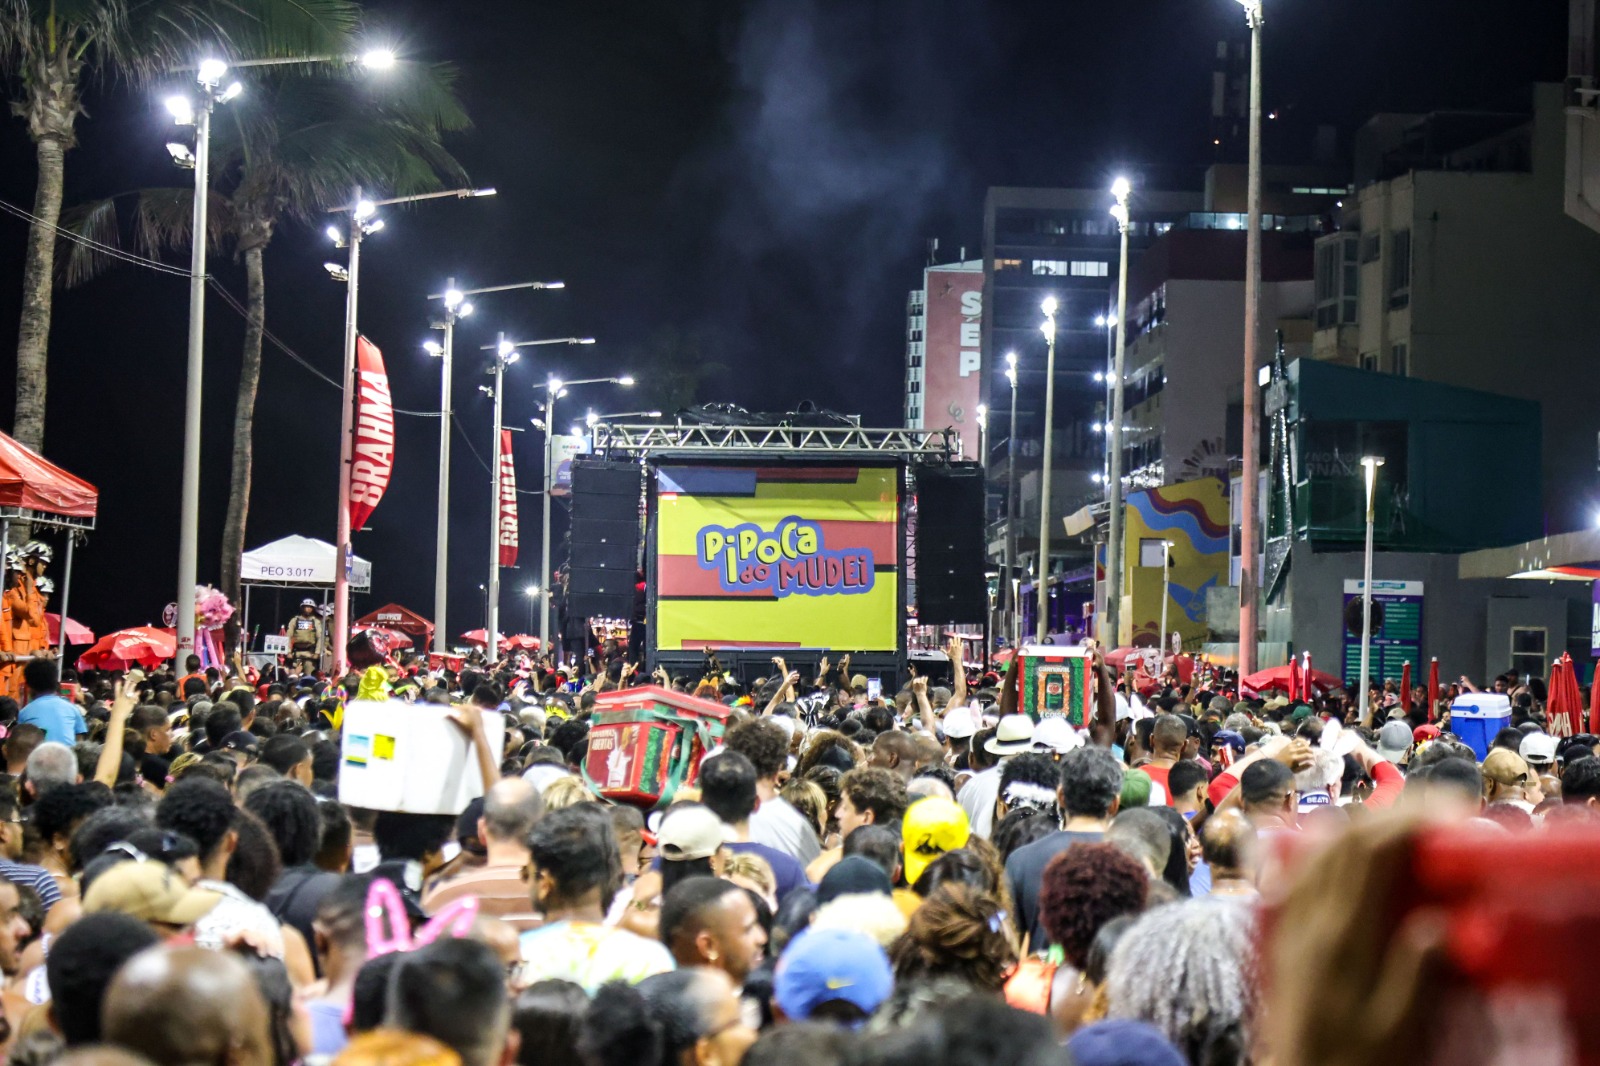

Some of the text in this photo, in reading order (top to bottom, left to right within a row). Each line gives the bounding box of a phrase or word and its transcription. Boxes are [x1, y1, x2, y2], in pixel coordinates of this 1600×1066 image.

[351, 371, 394, 507] BRAHMA
[500, 453, 519, 547] BRAHMA
[261, 566, 314, 577] PEO 3.017
[738, 563, 771, 584] do
